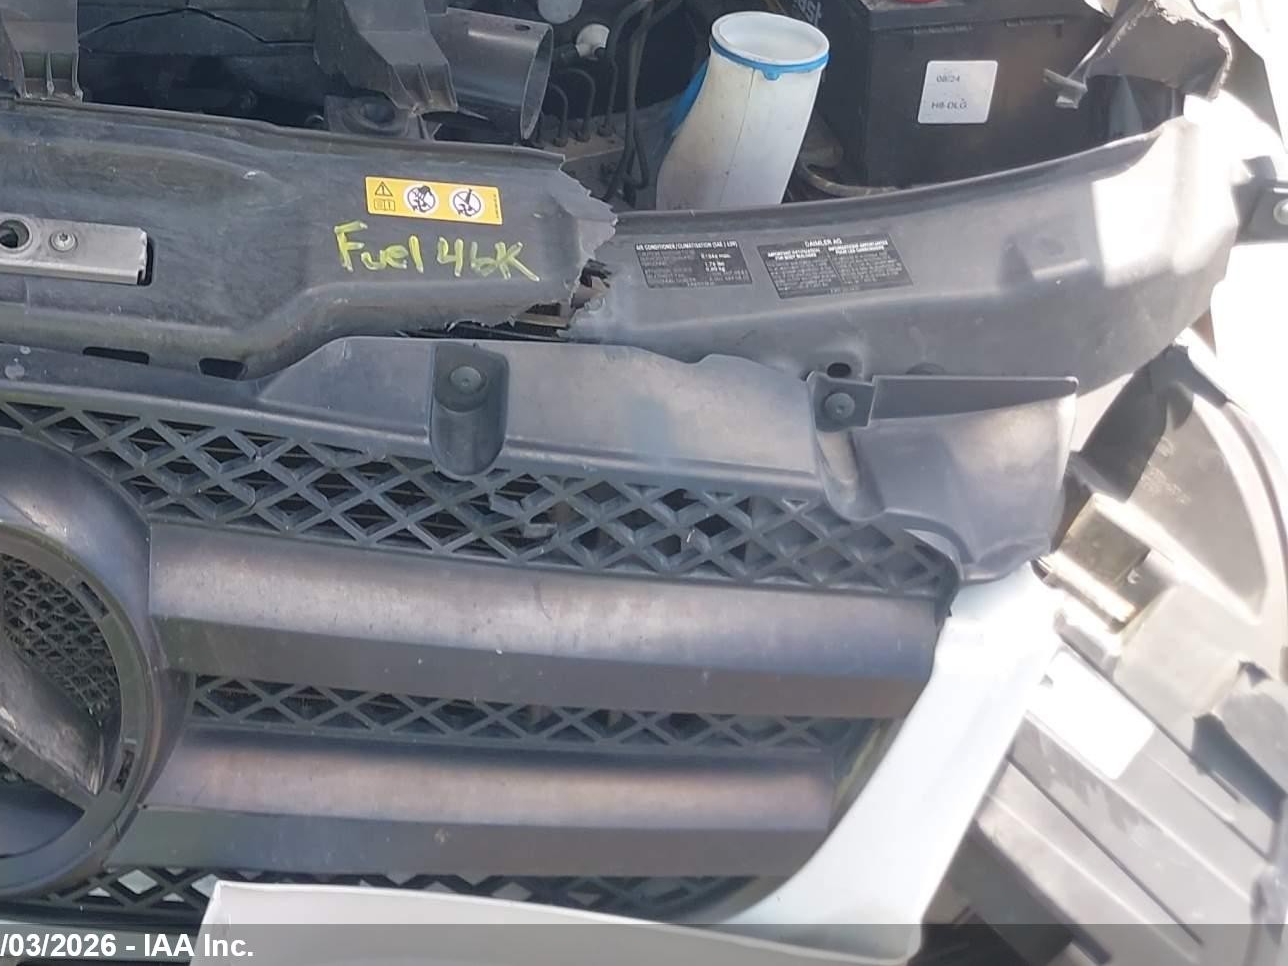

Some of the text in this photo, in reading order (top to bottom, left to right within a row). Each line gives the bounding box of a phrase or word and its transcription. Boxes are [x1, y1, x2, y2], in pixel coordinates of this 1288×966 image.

[333, 220, 541, 282] Fuel 46K
[804, 237, 842, 248] DAIMLER AG
